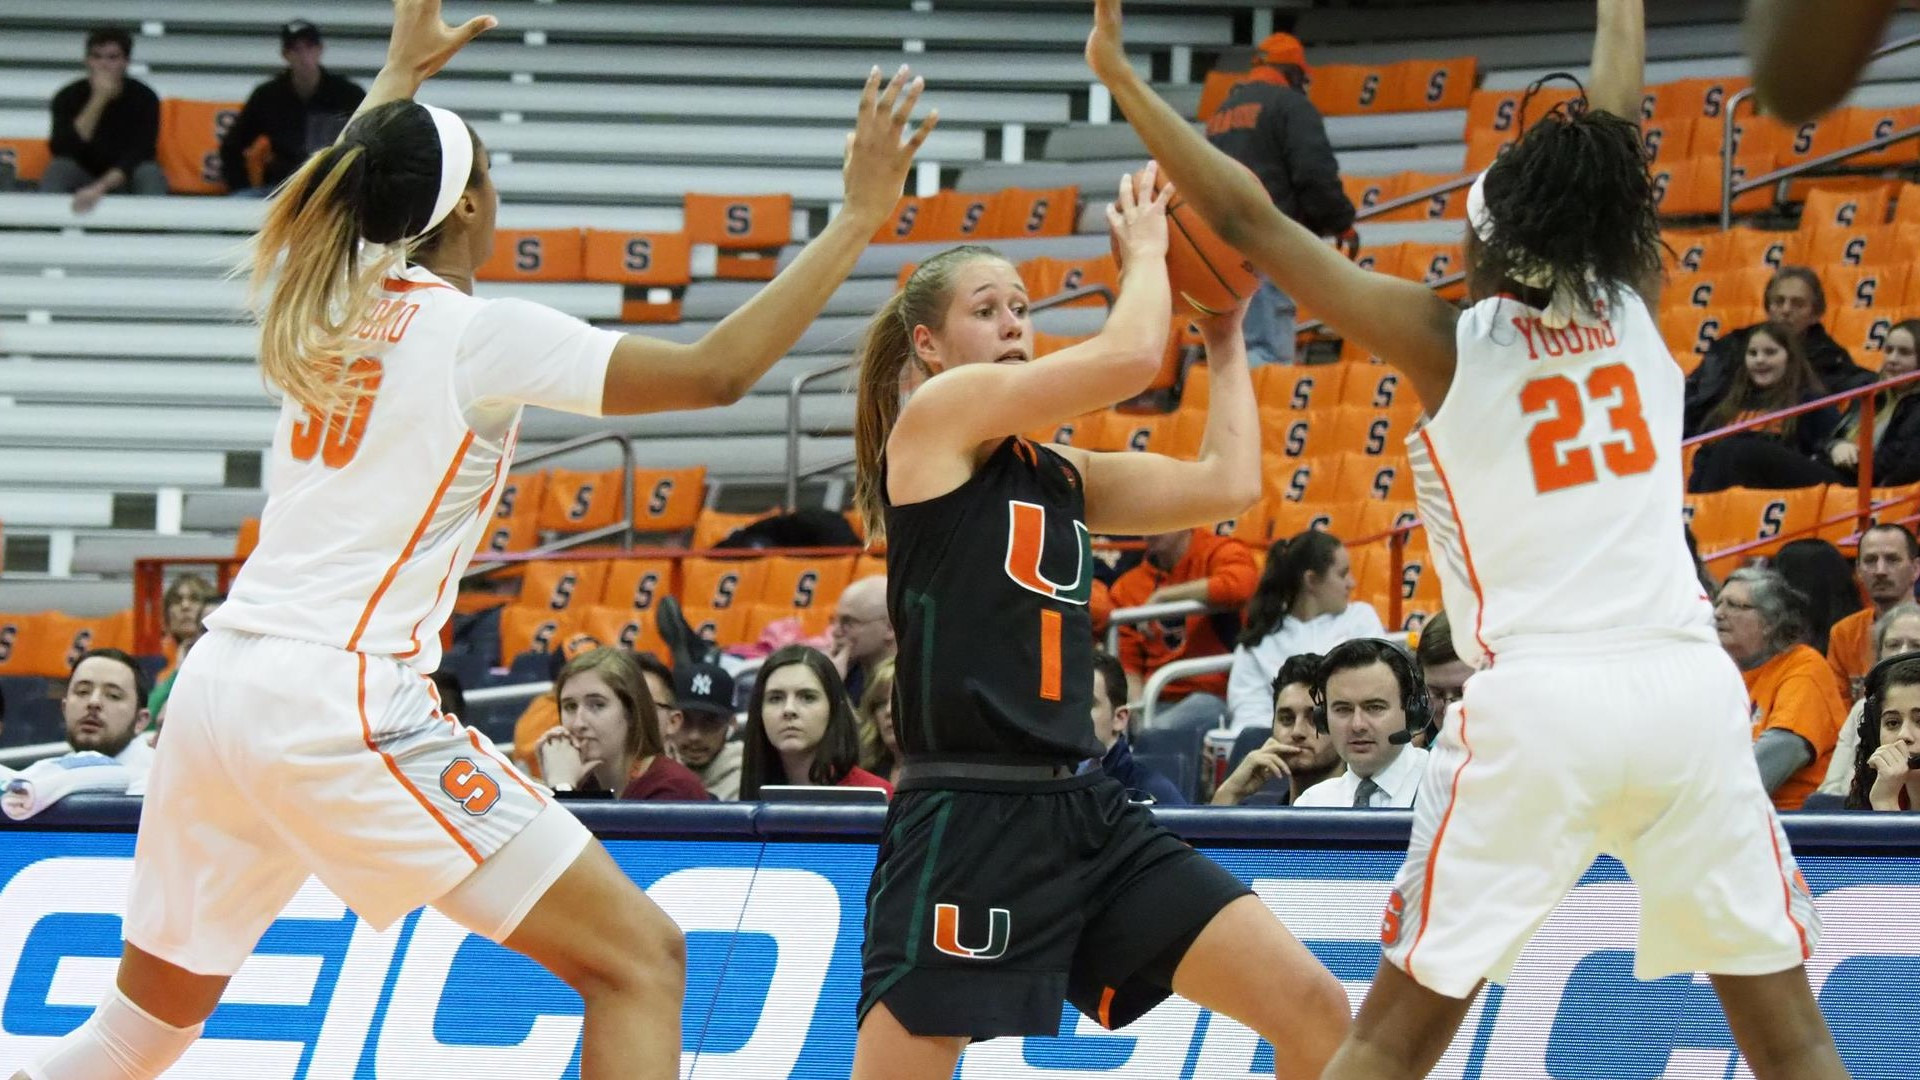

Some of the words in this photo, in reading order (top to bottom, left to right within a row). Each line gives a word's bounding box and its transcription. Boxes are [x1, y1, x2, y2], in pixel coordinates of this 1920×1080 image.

[1359, 75, 1379, 107] S
[1427, 70, 1447, 103] S
[1705, 86, 1723, 117] S
[1494, 100, 1515, 131] S
[1794, 122, 1815, 154] S
[727, 204, 752, 236] S
[897, 204, 918, 236] S
[963, 203, 984, 233] S
[1027, 200, 1049, 232] S
[516, 238, 541, 271] S
[626, 239, 651, 271] S
[1424, 255, 1448, 283] S
[1845, 239, 1865, 266] S
[1857, 279, 1876, 308] S
[1695, 320, 1719, 354] S
[1867, 320, 1891, 350] S
[1288, 378, 1313, 409] S
[1372, 376, 1396, 408] S
[1285, 421, 1309, 457] S
[1366, 418, 1389, 454] S
[1518, 360, 1659, 496] 23
[649, 480, 674, 515] S
[1286, 467, 1311, 502] S
[1374, 468, 1395, 500] S
[498, 485, 518, 517] S
[570, 485, 595, 519] S
[1759, 501, 1786, 538] S
[1004, 500, 1092, 606] U
[549, 575, 577, 610] S
[634, 574, 659, 610] S
[713, 574, 739, 609] S
[794, 572, 819, 608] S
[1401, 564, 1422, 599] S
[1040, 608, 1062, 701] 1
[440, 757, 501, 816] S
[933, 903, 1011, 959] U
